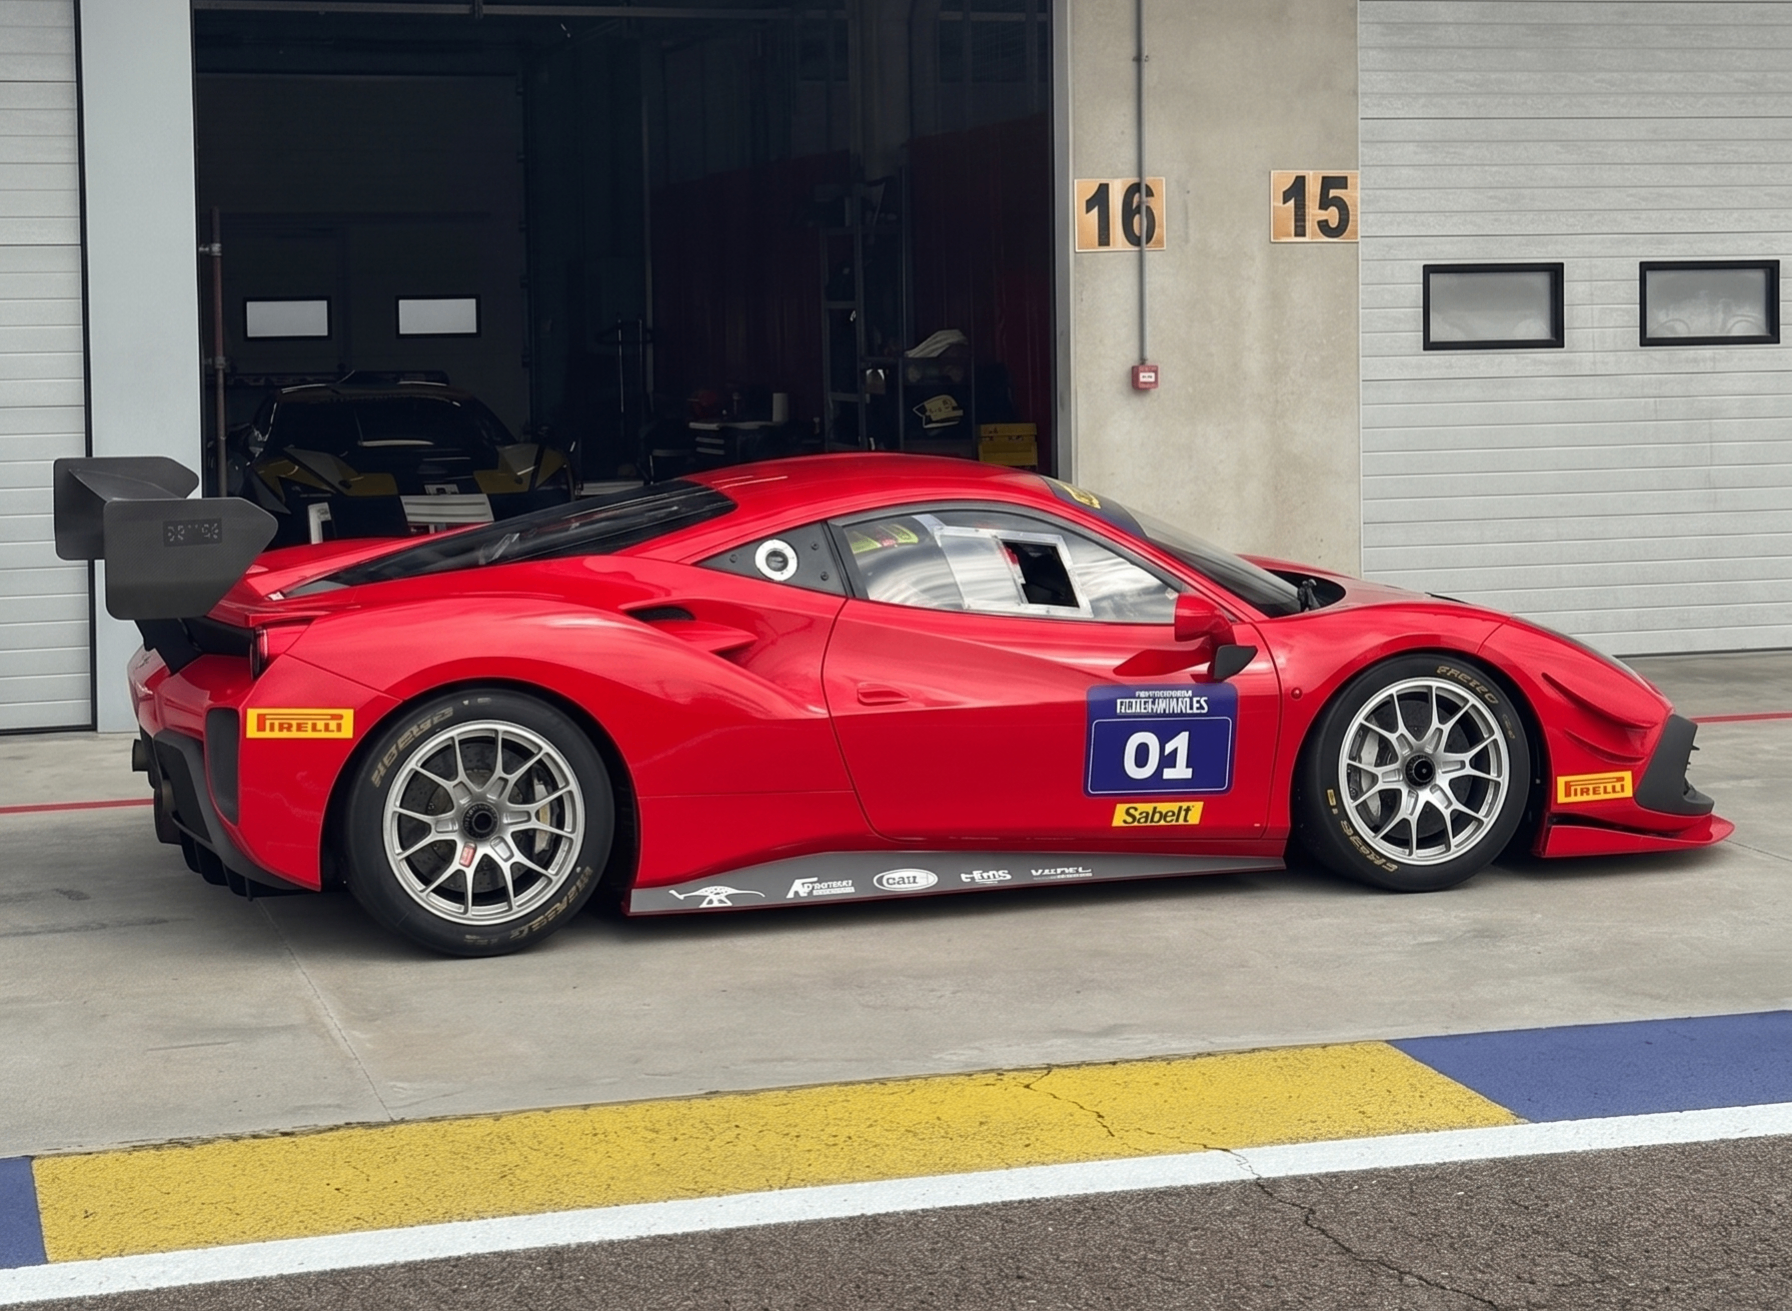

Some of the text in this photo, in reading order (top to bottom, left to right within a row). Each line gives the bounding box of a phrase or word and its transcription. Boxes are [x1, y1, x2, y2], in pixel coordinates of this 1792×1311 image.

[1085, 182, 1156, 247] 16
[1282, 175, 1350, 238] 15
[256, 713, 344, 733] PIRELLI
[1124, 731, 1193, 779] 01
[1564, 776, 1625, 798] PIRELLI
[1122, 805, 1191, 825] Sabelt
